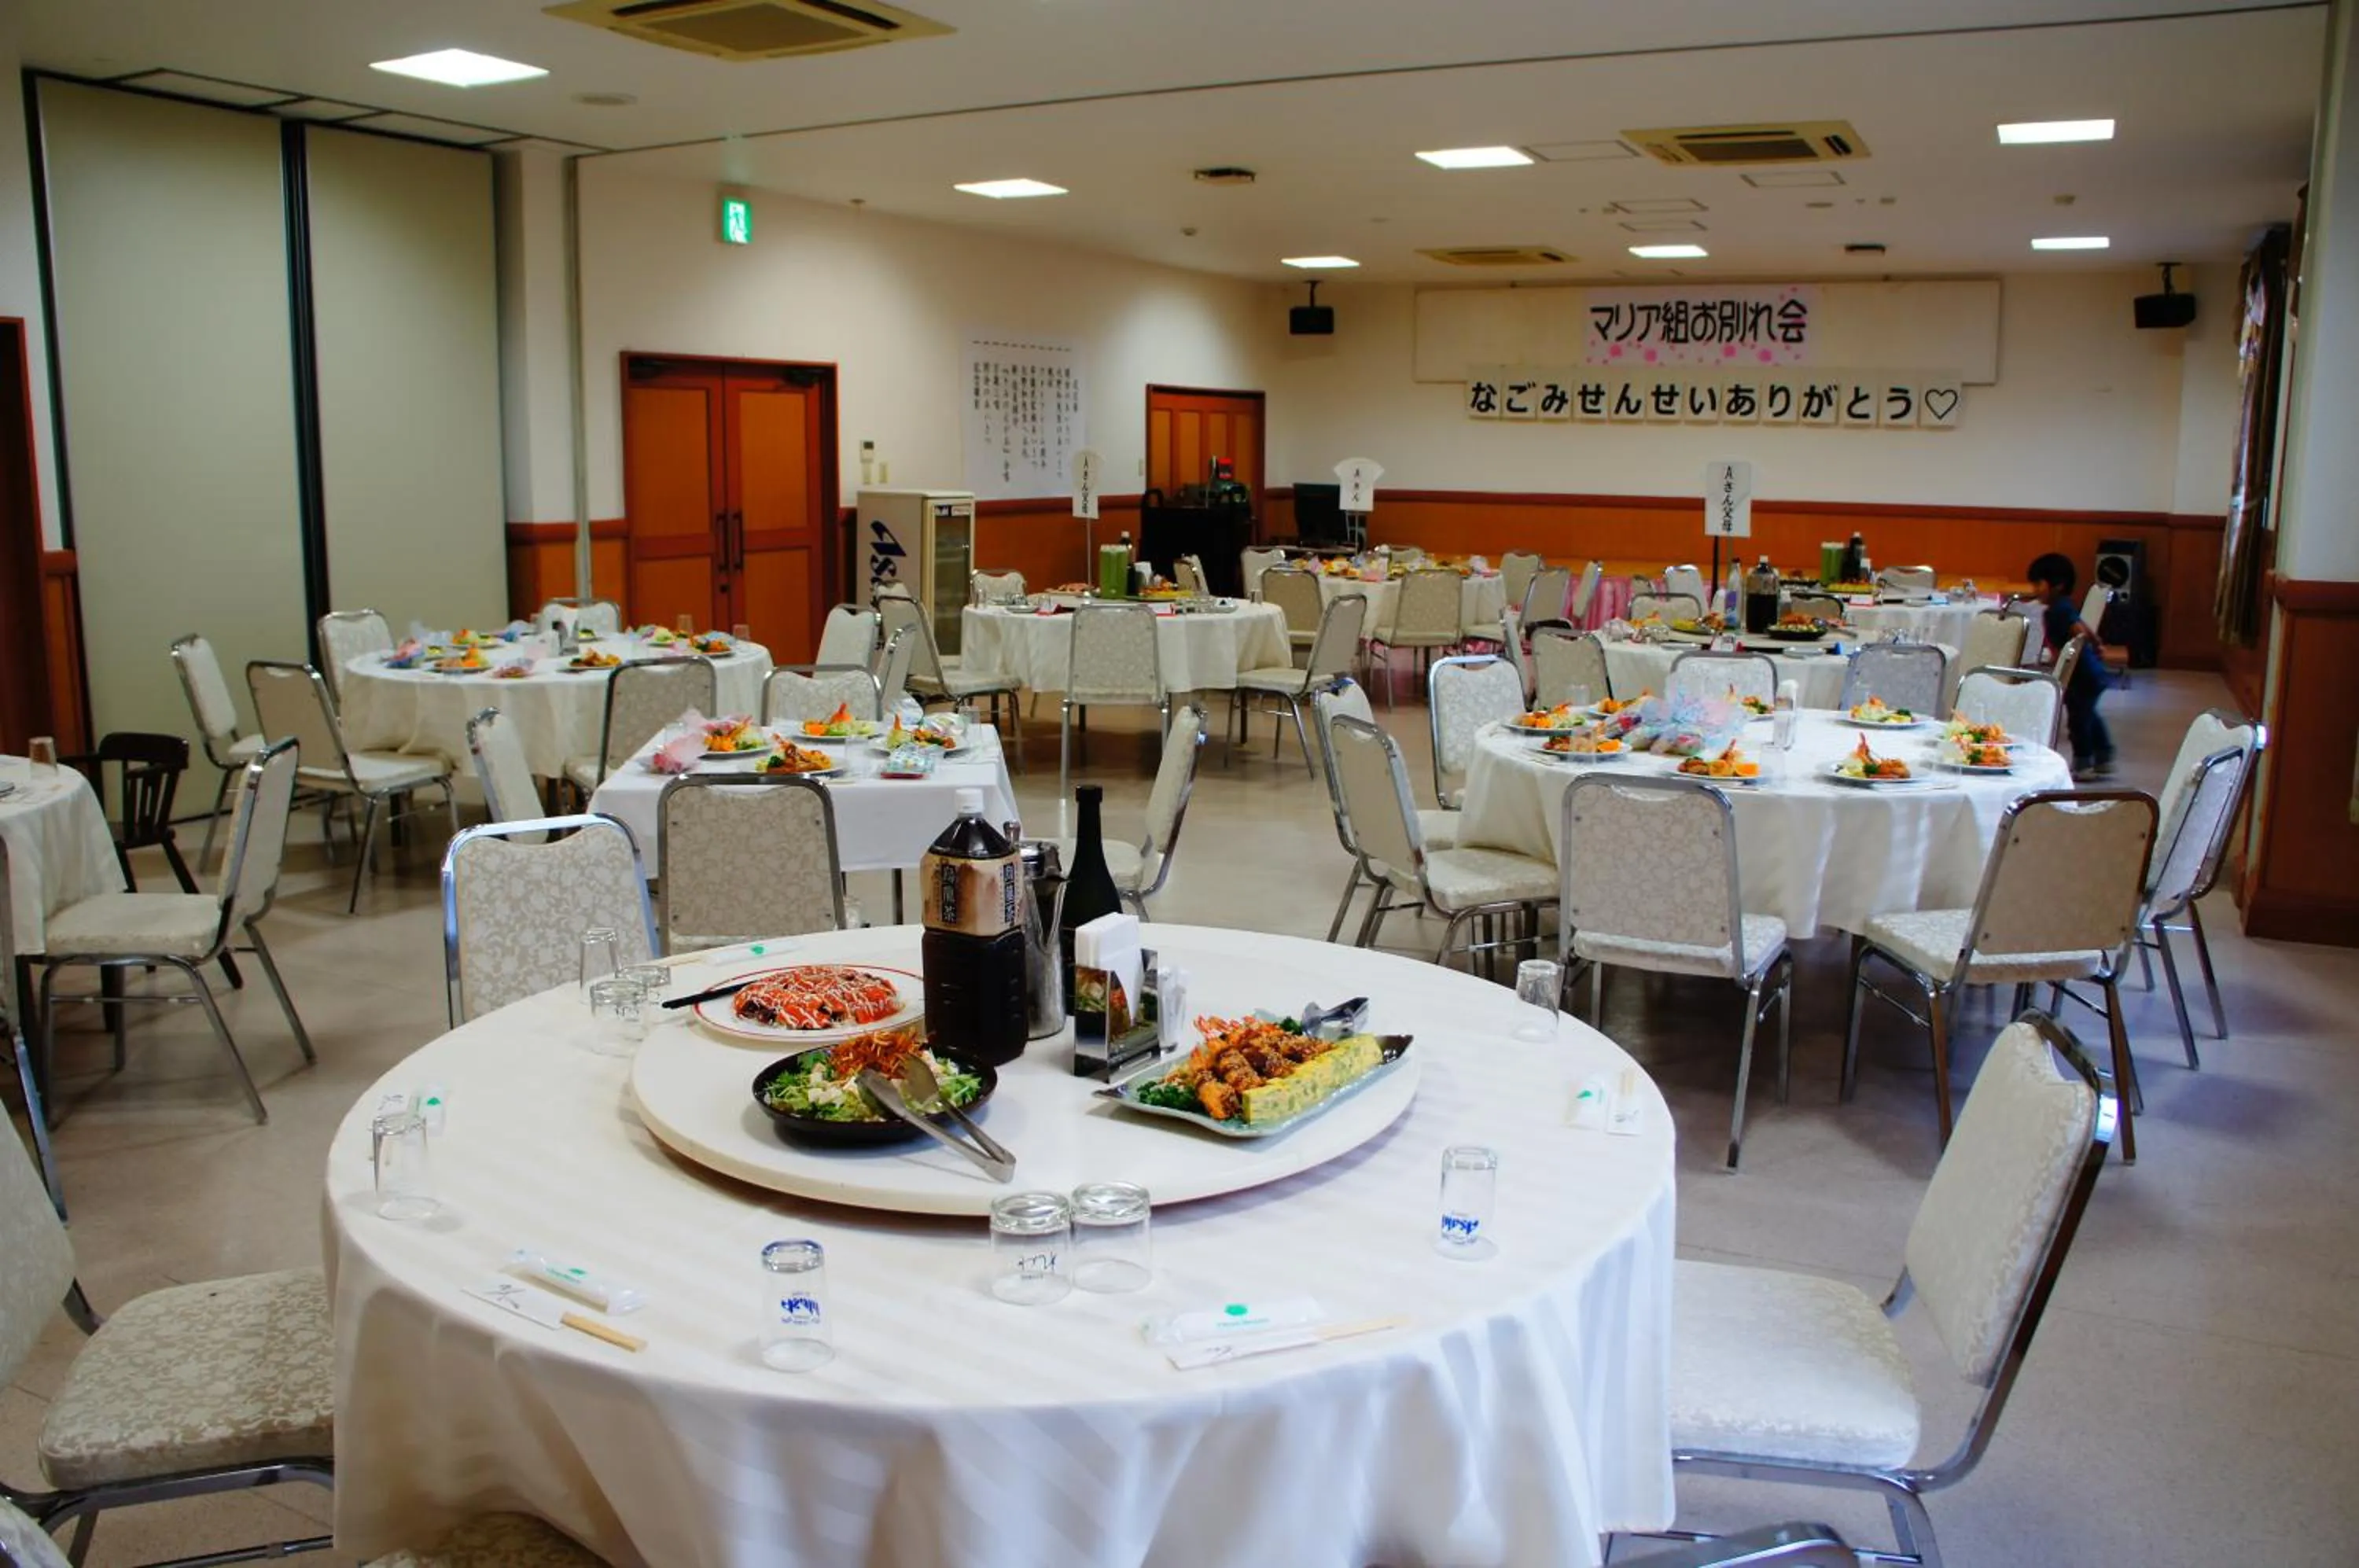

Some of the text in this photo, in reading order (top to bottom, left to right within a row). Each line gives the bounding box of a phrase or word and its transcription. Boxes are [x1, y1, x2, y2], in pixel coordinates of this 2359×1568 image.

[1590, 299, 1808, 344] マリア組お別れ会
[1470, 382, 1914, 419] なごみせんせいありがとう
